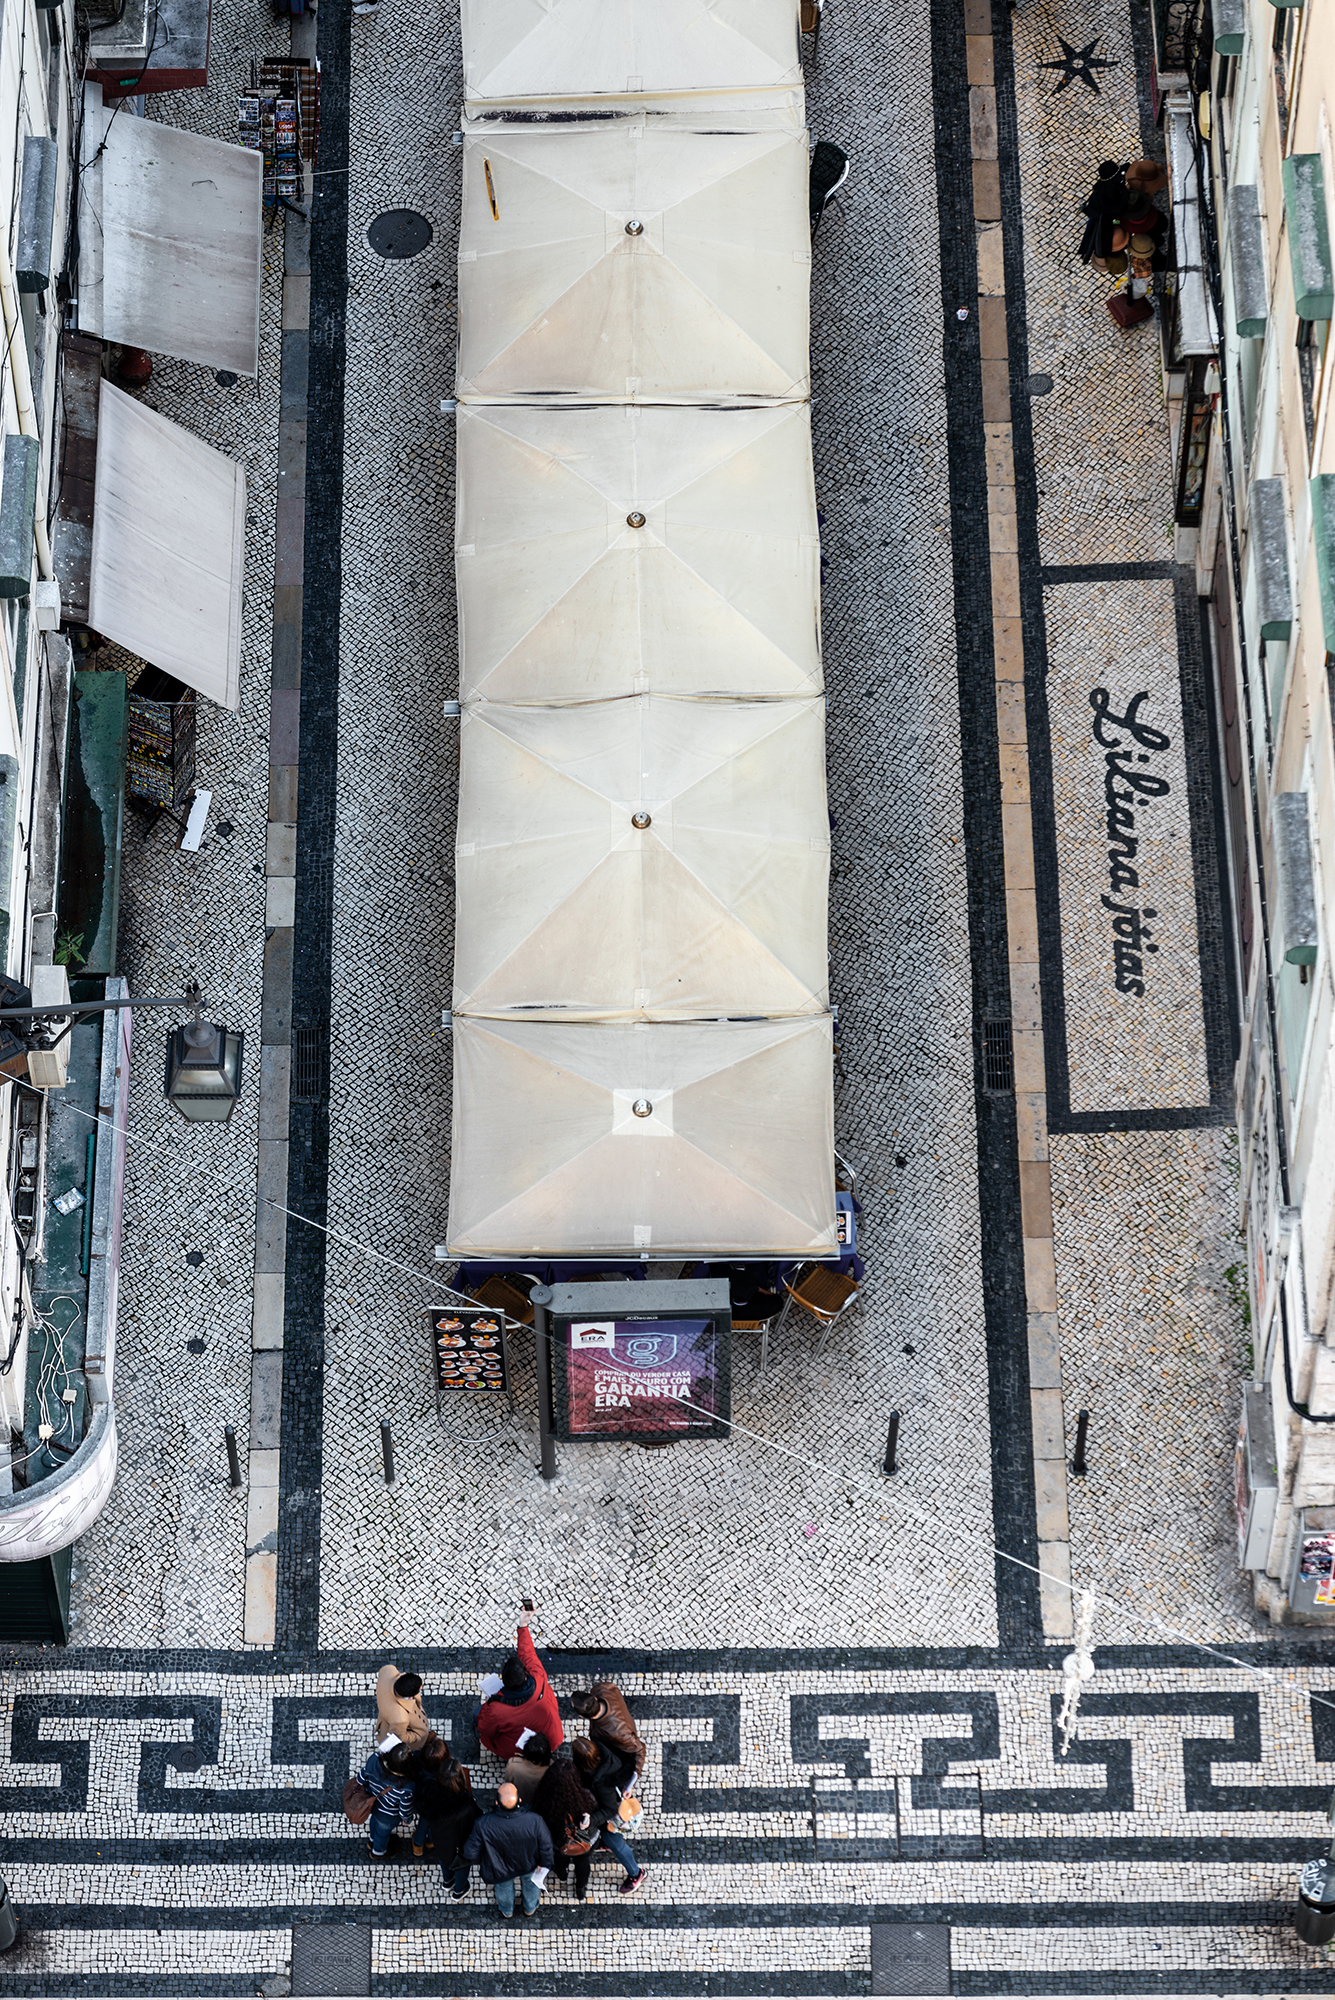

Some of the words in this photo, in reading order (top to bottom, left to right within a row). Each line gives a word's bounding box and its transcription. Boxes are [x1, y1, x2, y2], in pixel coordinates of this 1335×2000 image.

[1089, 687, 1171, 893] Liliana
[603, 1375, 627, 1384] MAIS
[670, 1377, 691, 1385] COM
[672, 1370, 691, 1378] CASA
[594, 1382, 692, 1398] GARANTIA
[594, 1393, 632, 1407] ERA
